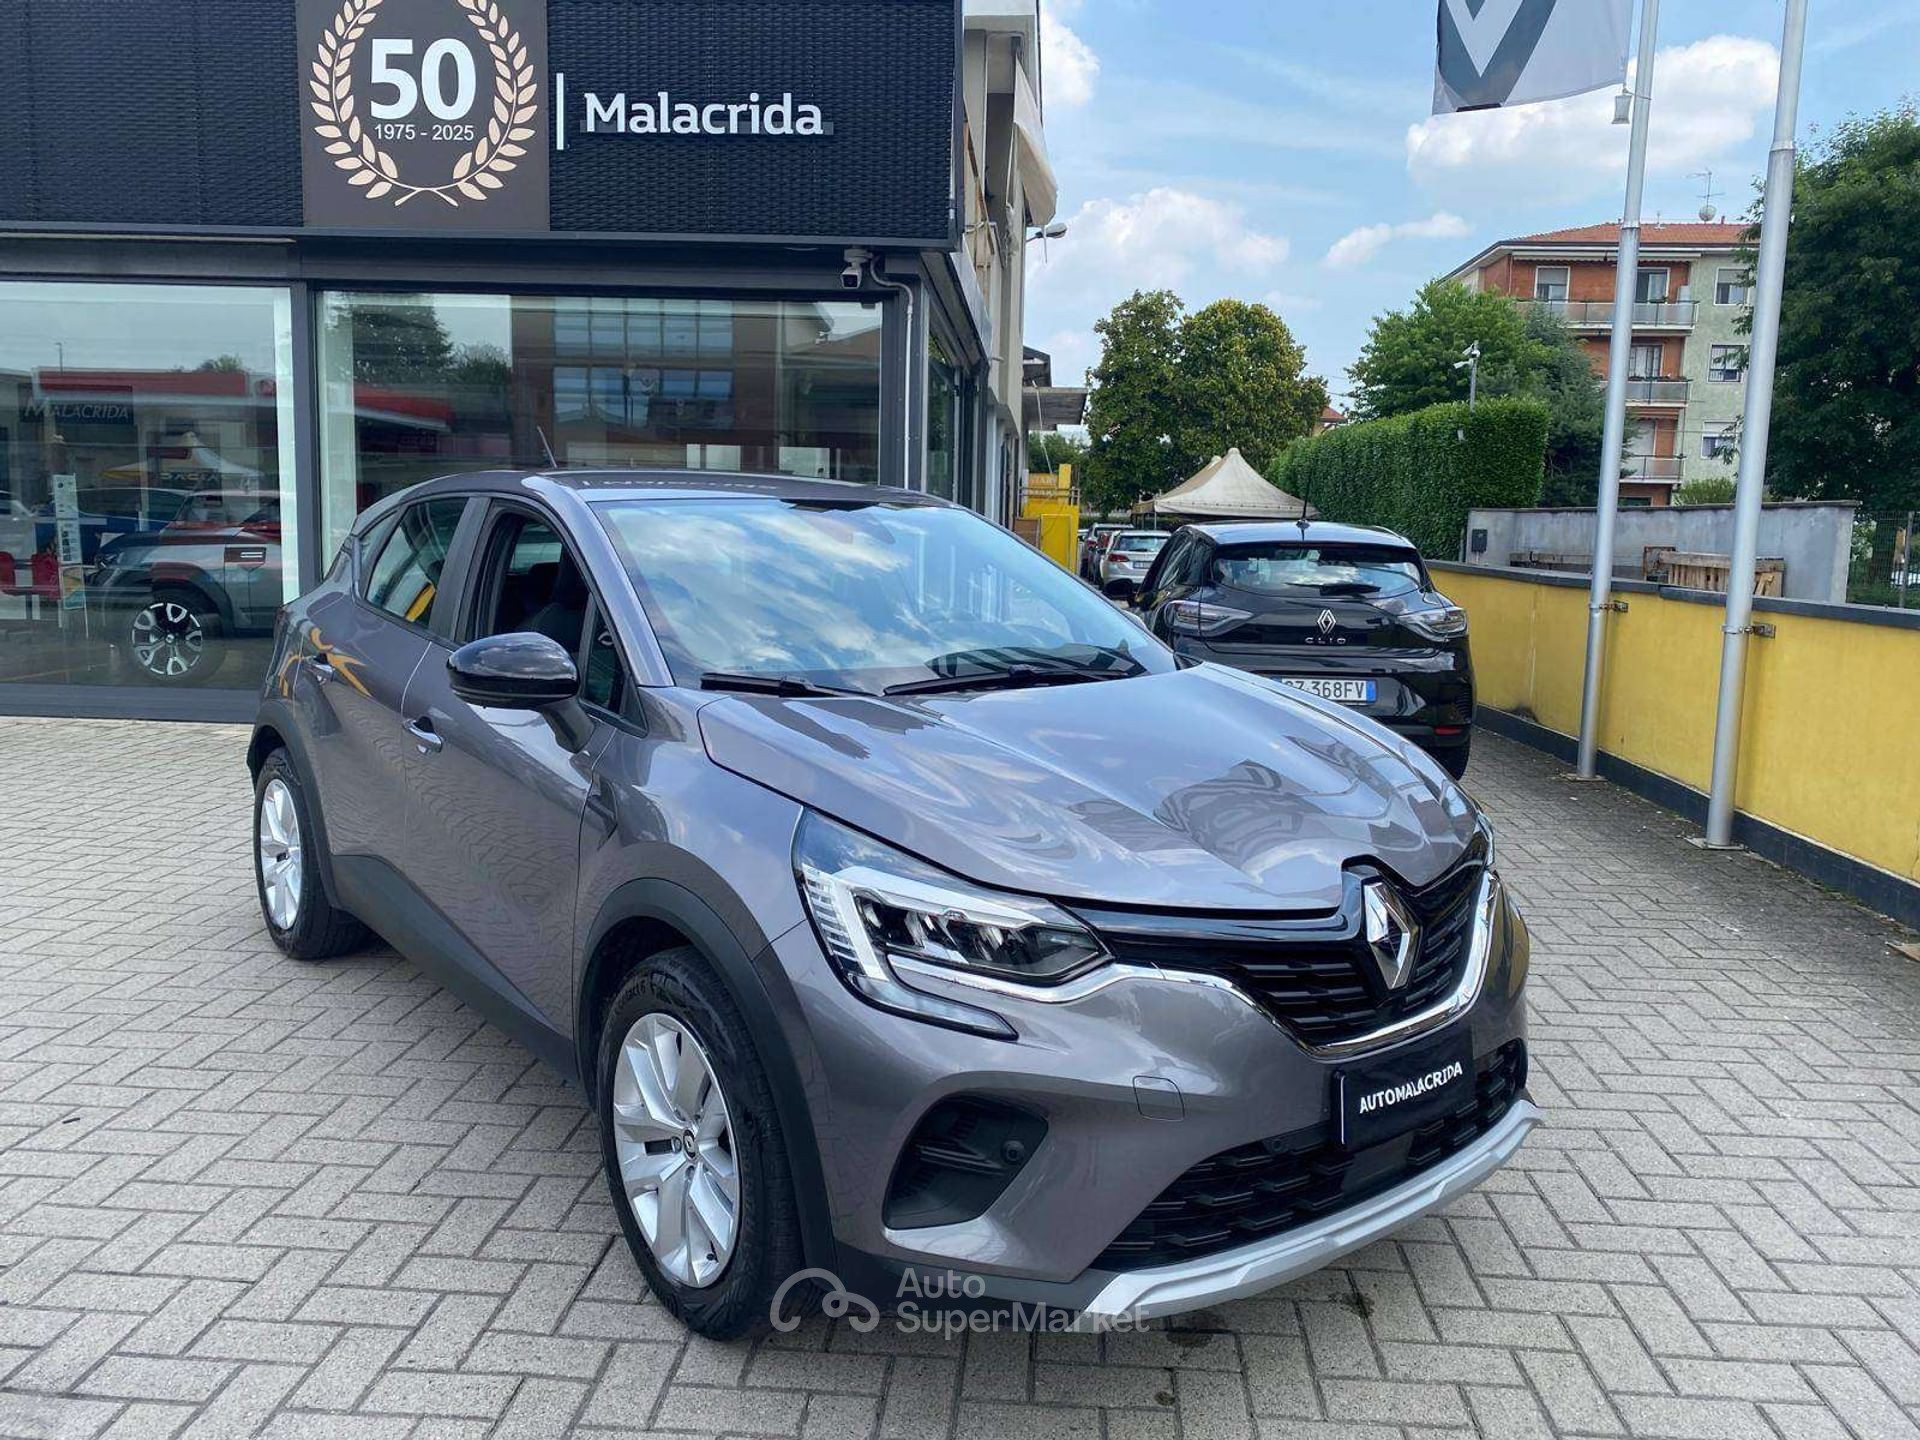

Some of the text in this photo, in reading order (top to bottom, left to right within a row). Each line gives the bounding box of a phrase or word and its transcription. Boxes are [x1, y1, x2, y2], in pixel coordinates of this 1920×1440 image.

[370, 38, 476, 120] 50
[374, 123, 416, 140] 1975
[432, 124, 474, 141] 2025
[583, 91, 824, 135] Malacrida
[1304, 637, 1346, 645] CLIO
[1359, 1061, 1463, 1114] AUTOMALACRIDA
